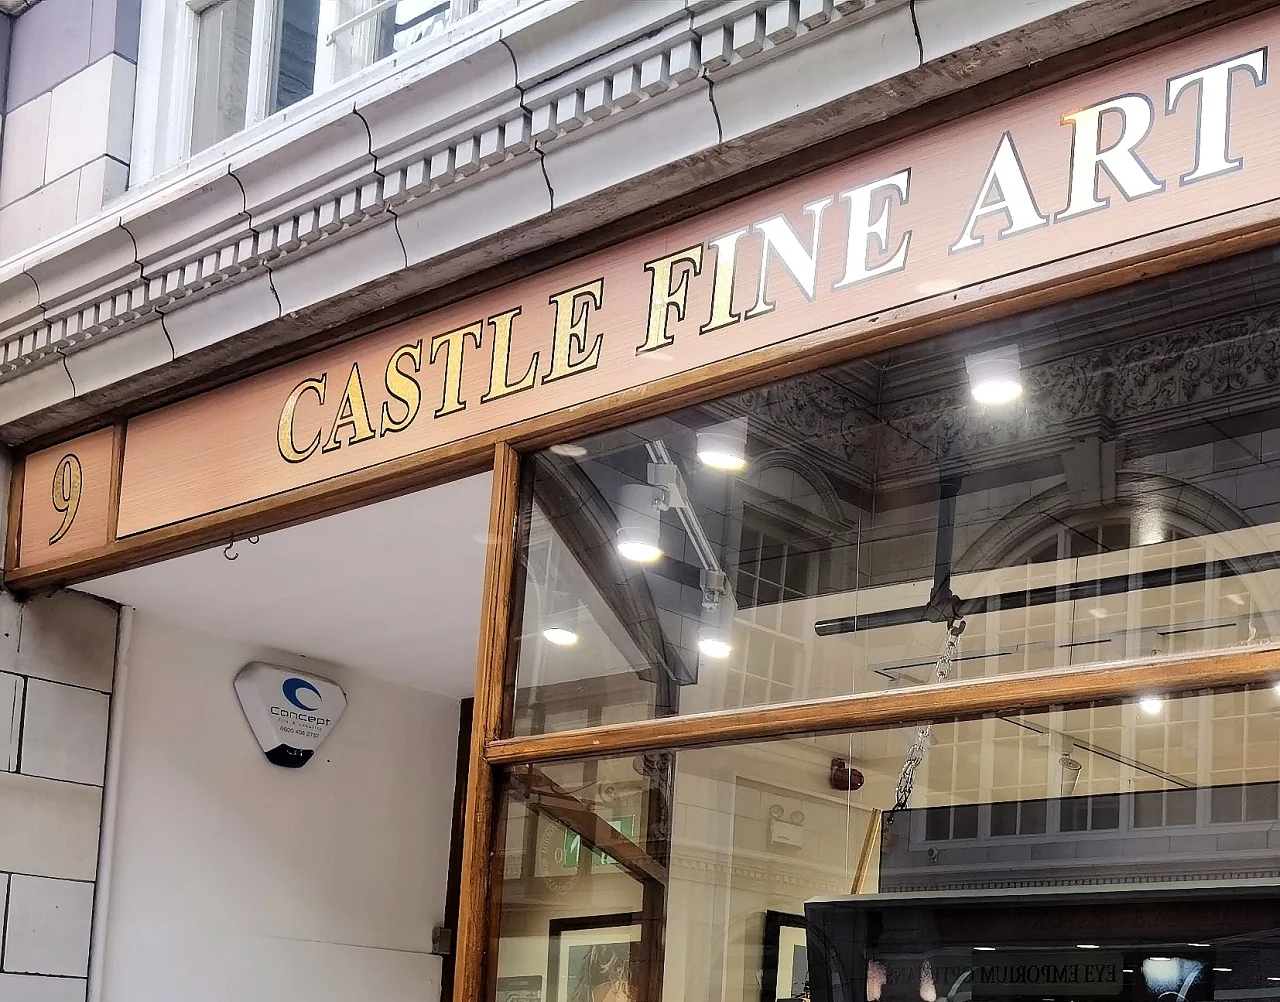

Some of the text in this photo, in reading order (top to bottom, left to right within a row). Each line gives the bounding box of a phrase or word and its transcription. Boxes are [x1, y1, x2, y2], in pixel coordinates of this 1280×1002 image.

[276, 45, 1269, 464] CASTLE FINE ART
[49, 453, 83, 546] 9
